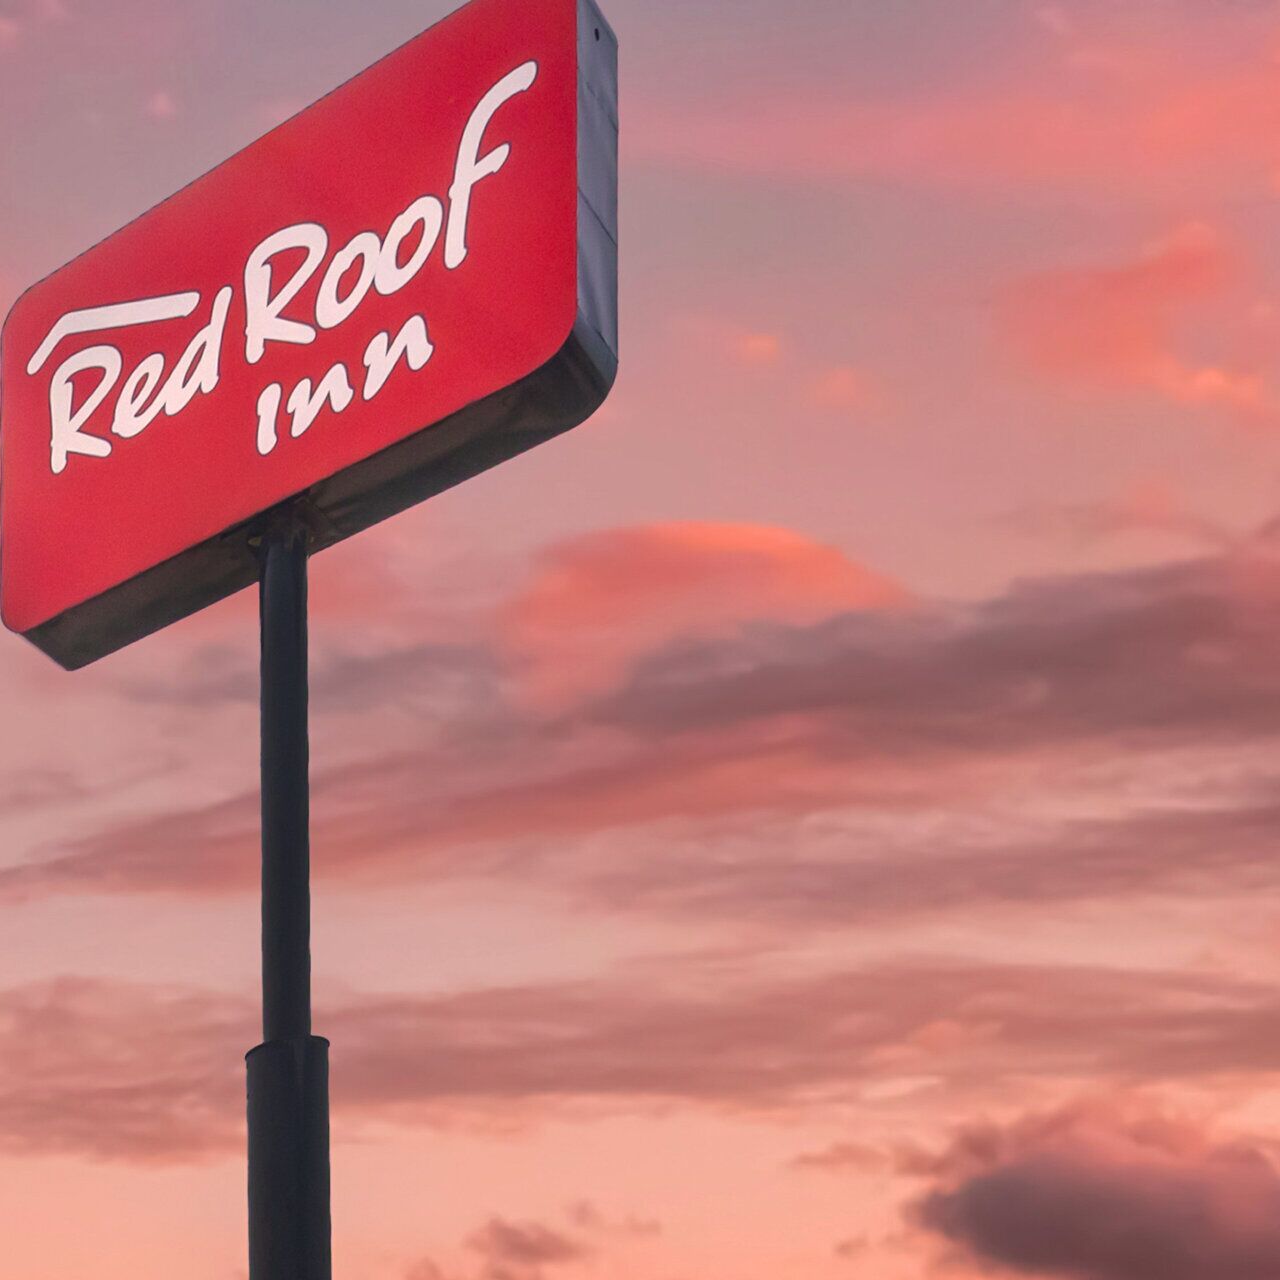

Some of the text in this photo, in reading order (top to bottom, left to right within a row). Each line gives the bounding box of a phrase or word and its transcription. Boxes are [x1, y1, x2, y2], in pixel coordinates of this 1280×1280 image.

[50, 60, 538, 474] Red Roof
[255, 314, 434, 455] Inn
